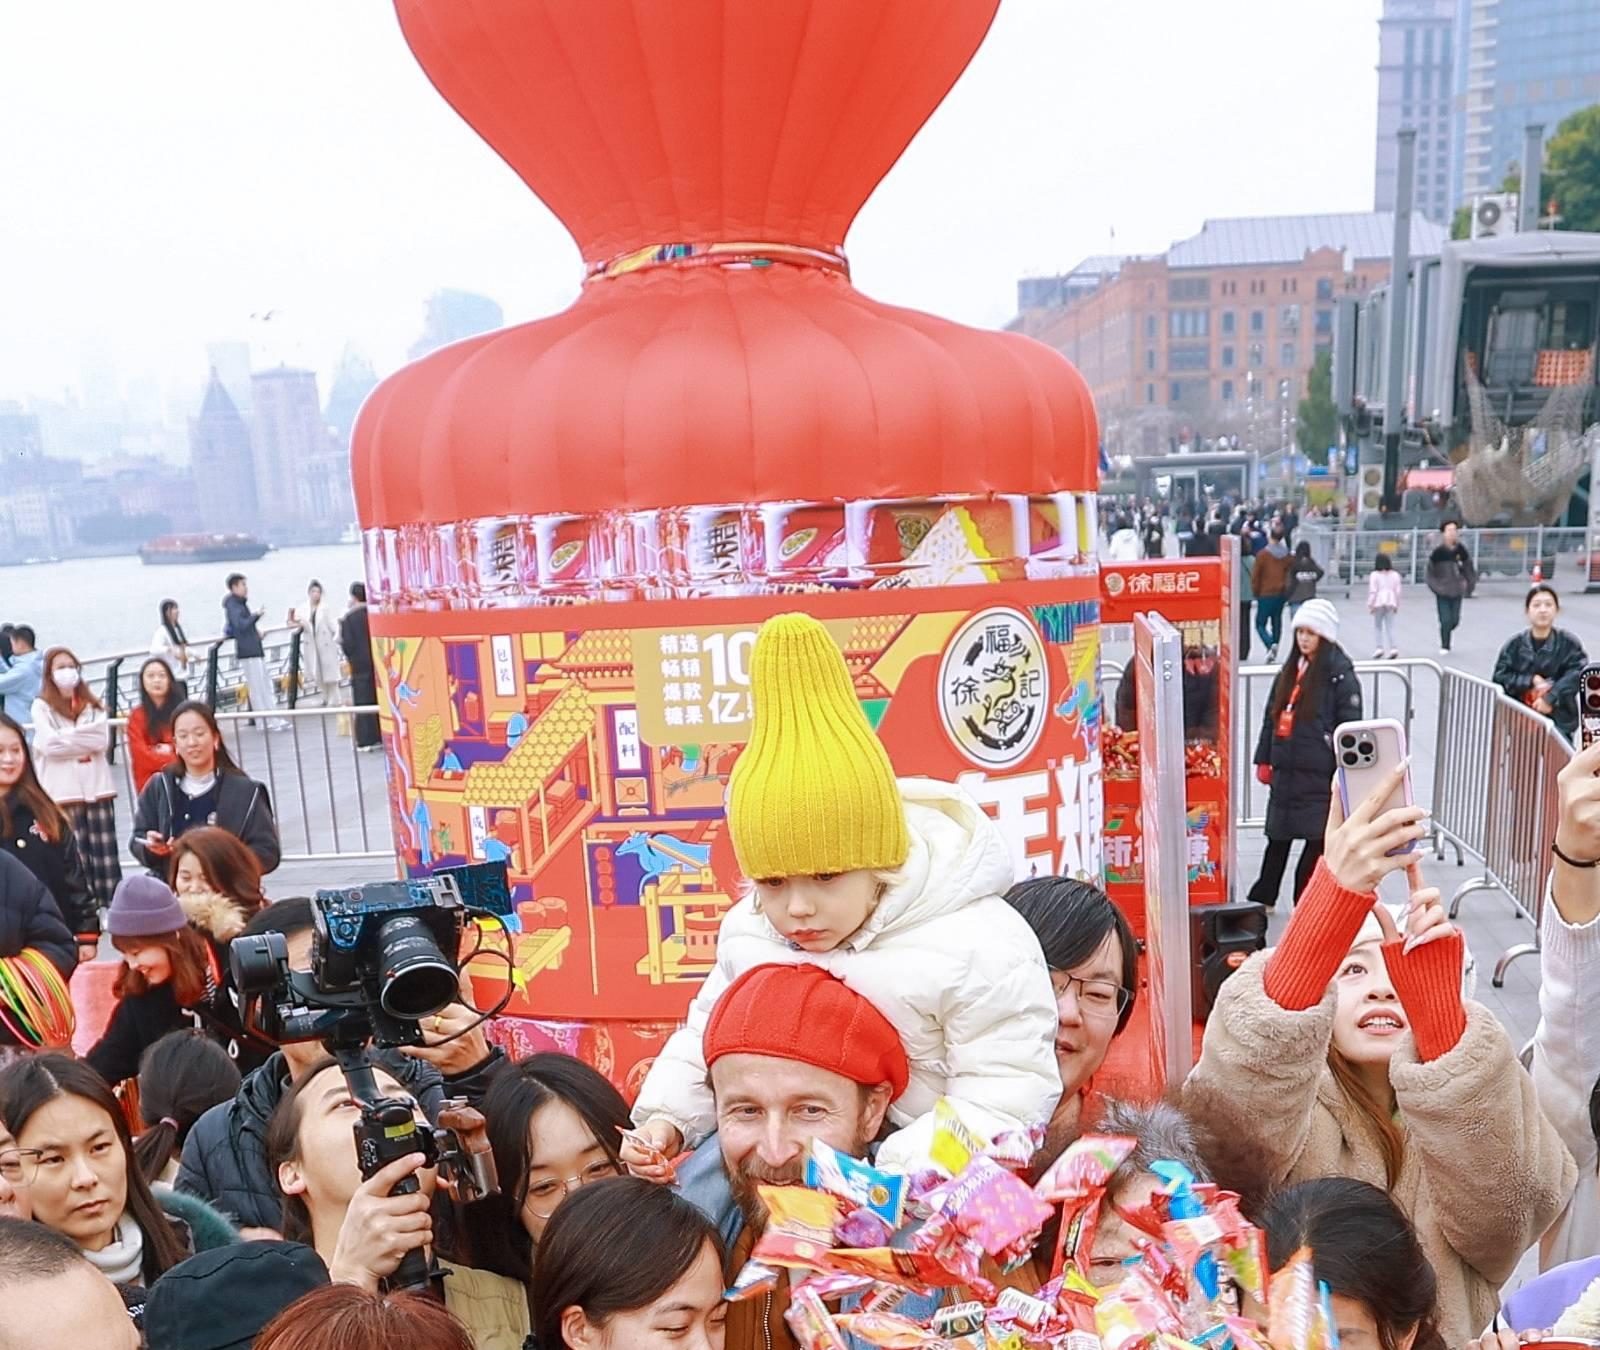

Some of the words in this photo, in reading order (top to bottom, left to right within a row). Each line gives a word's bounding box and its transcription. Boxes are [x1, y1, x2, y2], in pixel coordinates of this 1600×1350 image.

[1128, 571, 1200, 594] 徐福記
[659, 633, 700, 654] 精选
[661, 658, 700, 678] 畅销
[663, 682, 701, 702] 爆款
[664, 706, 704, 726] 糖果
[618, 721, 637, 758] 配料
